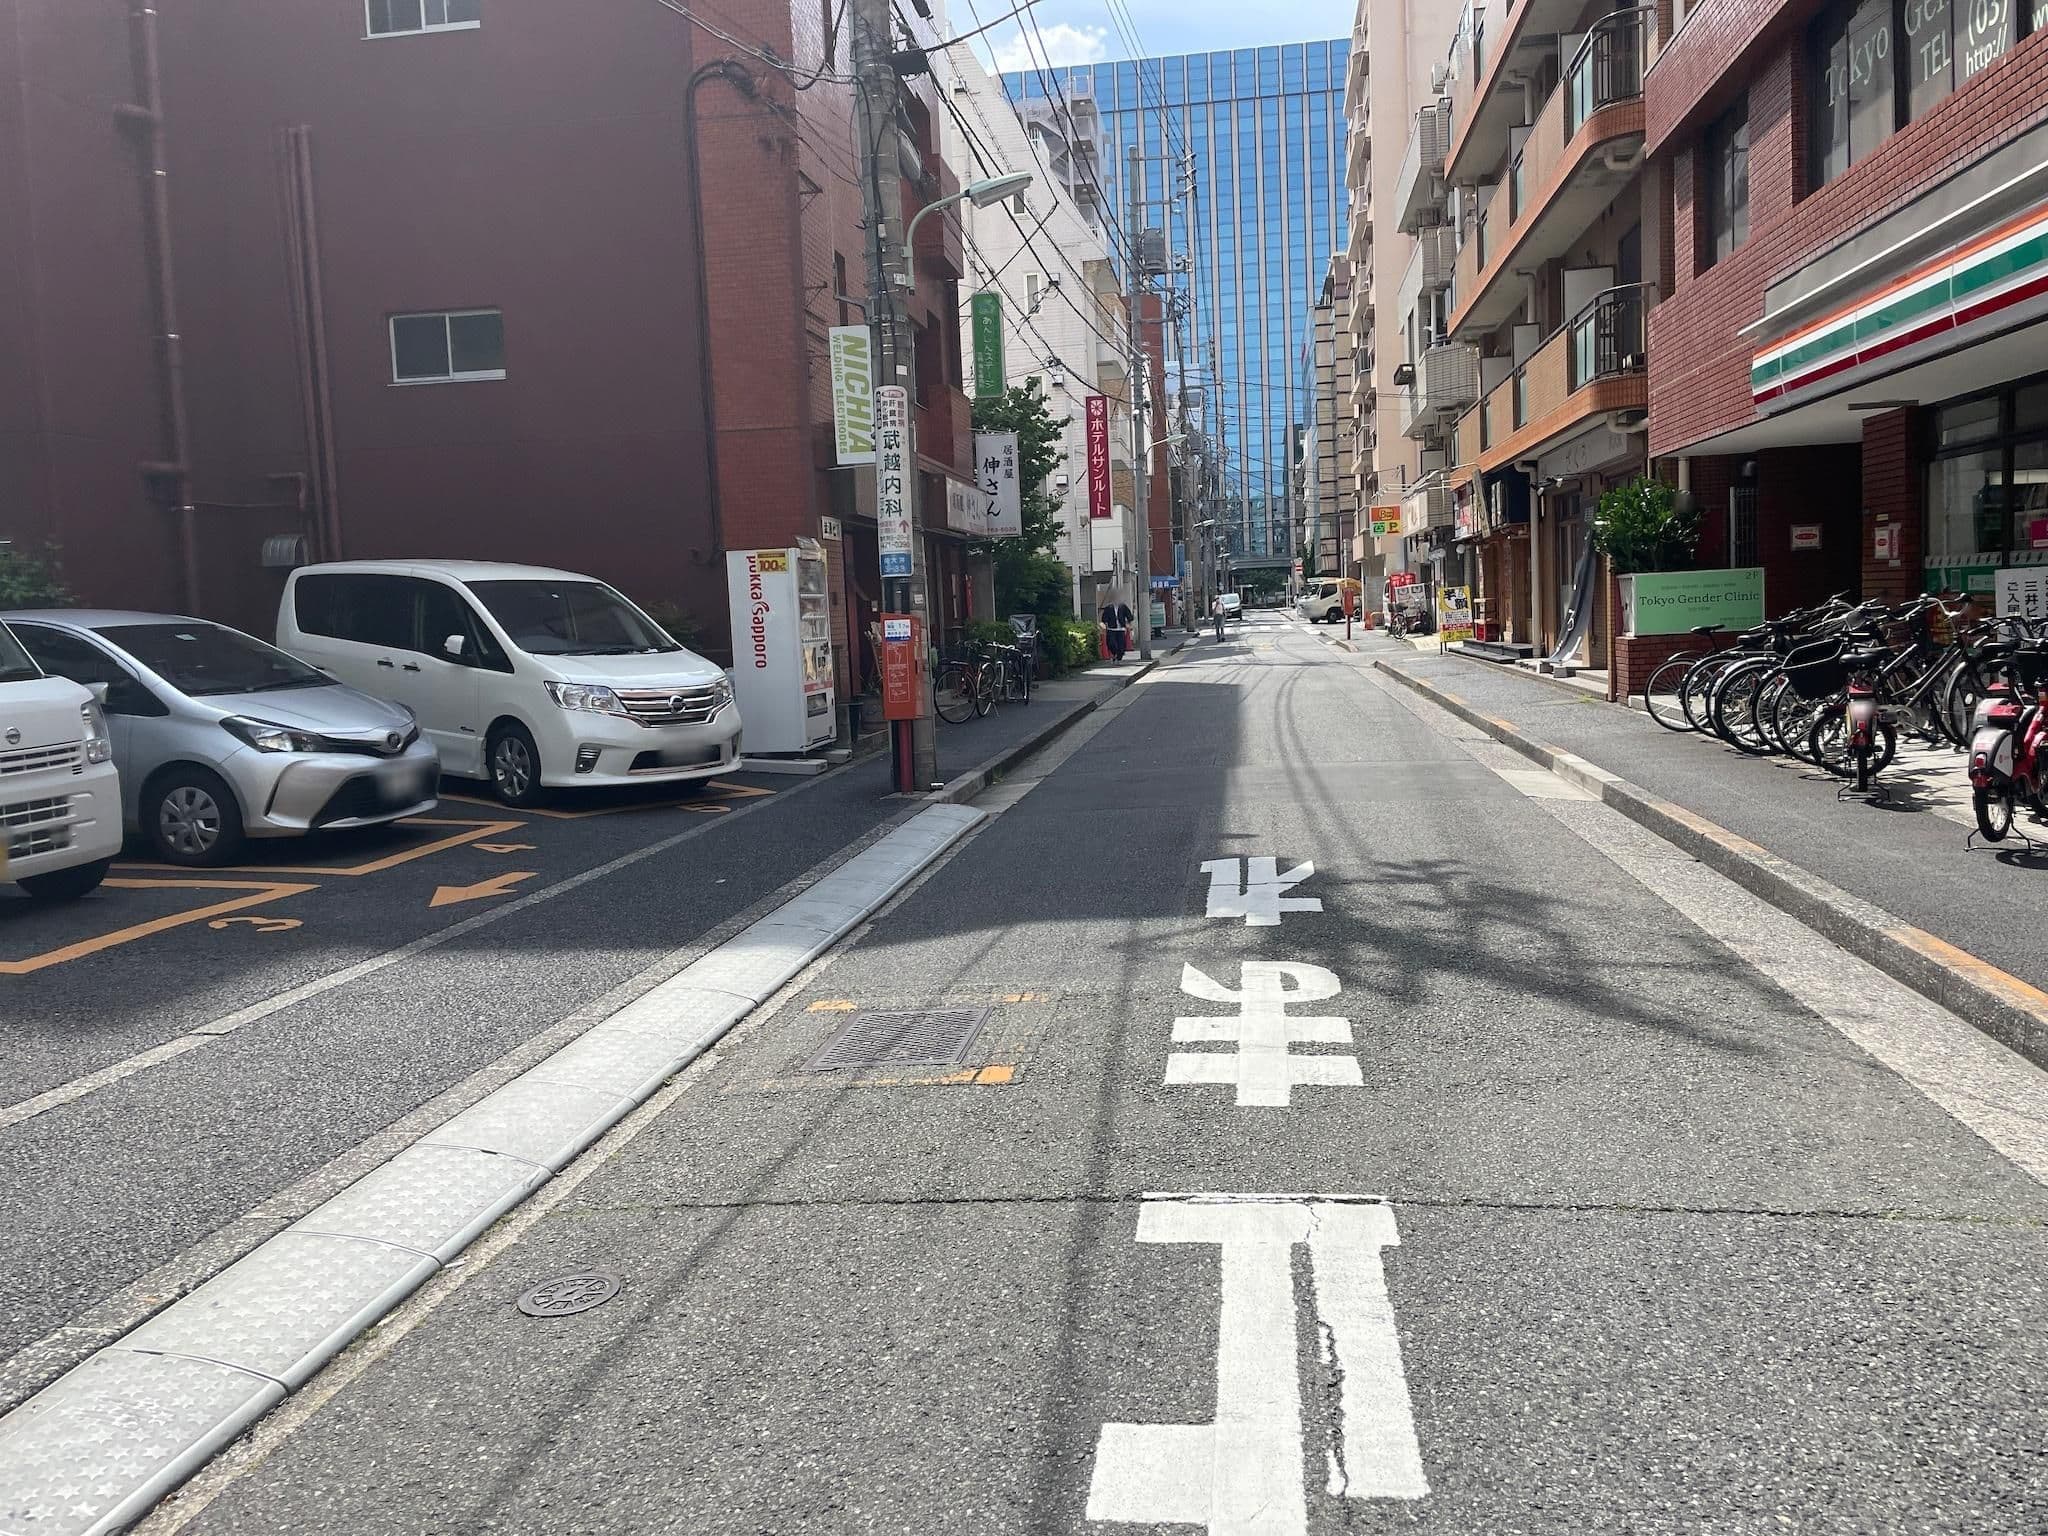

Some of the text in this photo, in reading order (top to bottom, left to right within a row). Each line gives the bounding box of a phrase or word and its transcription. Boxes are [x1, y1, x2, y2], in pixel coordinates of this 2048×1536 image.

[1825, 27, 1888, 107] Tokyo
[1920, 30, 1951, 81] TEL
[1966, 24, 2008, 77] http://
[832, 334, 848, 454] WELDING ELECTRODES
[842, 334, 872, 453] NICHIA
[883, 430, 902, 518] 武越内科
[1002, 445, 1014, 479] 居酒屋
[1091, 419, 1106, 514] ホテルサンルート
[1639, 591, 1761, 608] Tokyo Gender Clinic
[751, 606, 767, 669] sapporo
[207, 916, 303, 932] 3
